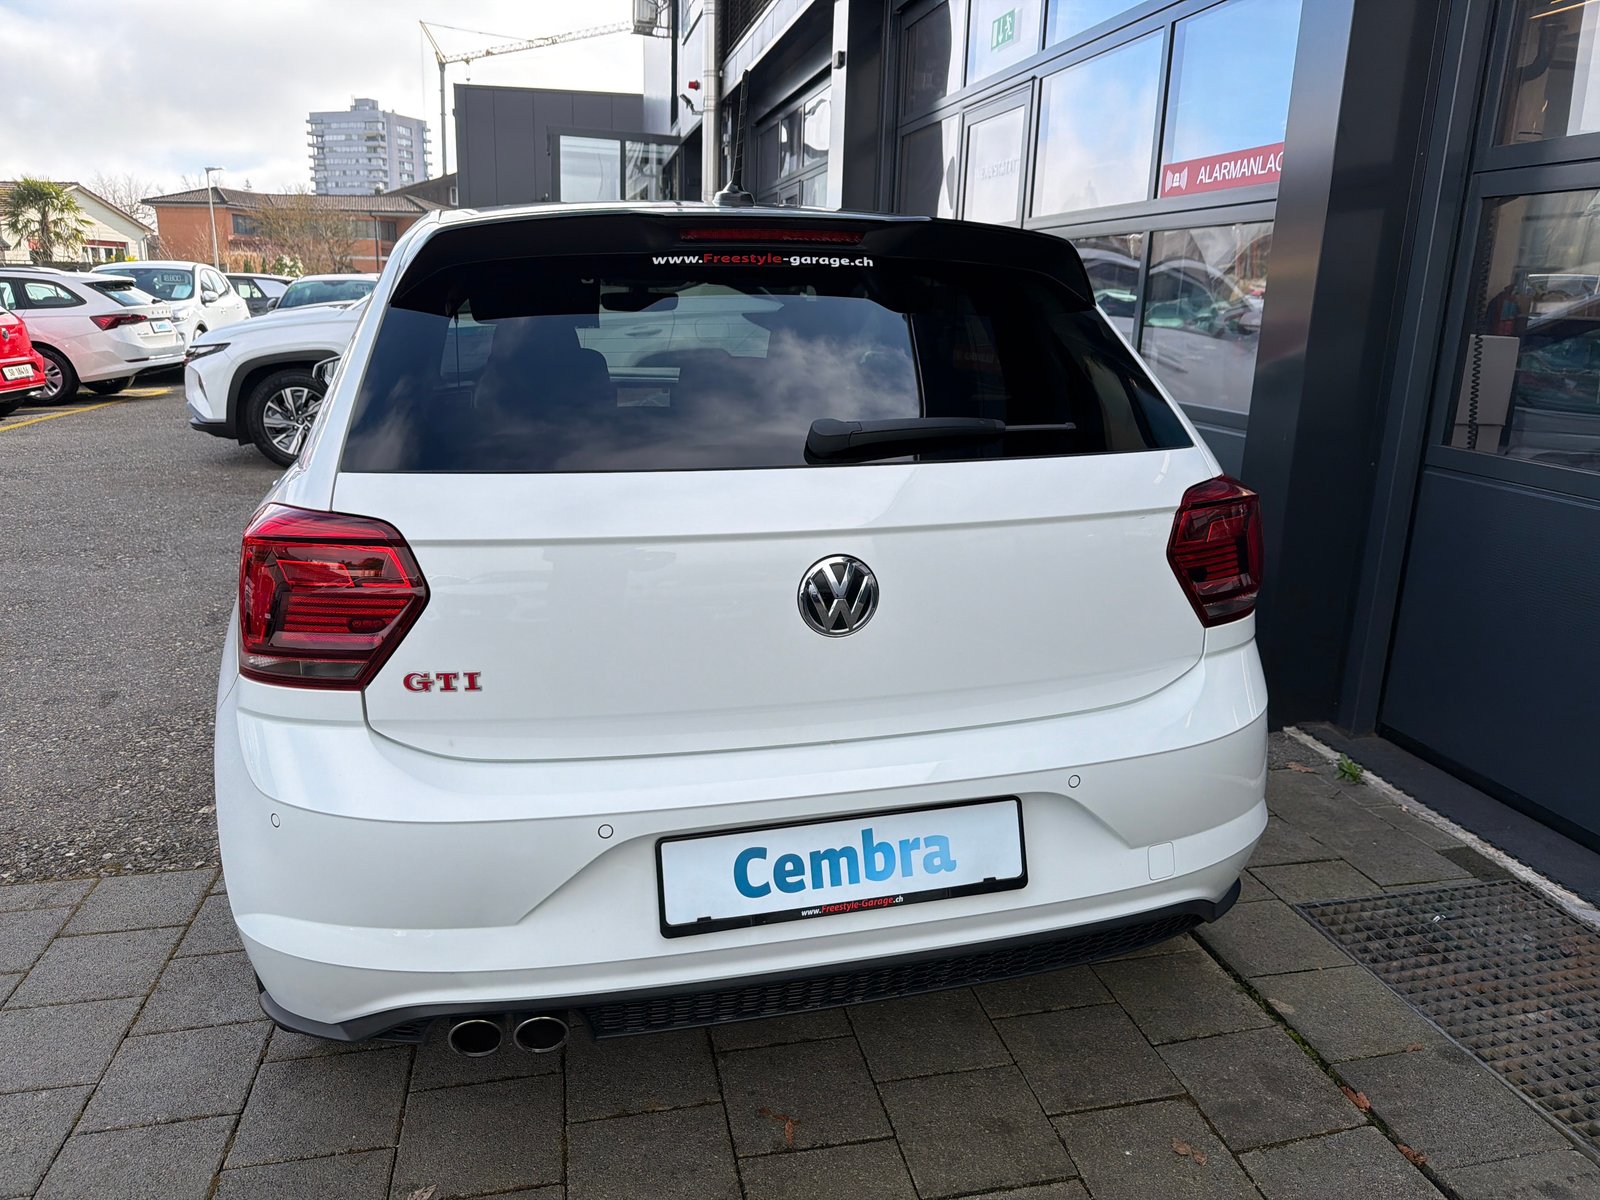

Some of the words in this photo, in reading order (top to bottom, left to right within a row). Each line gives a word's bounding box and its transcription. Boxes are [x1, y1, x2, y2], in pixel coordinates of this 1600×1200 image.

[652, 253, 875, 268] www.Freestyle-garage.ch
[403, 671, 482, 692] GTI
[733, 827, 957, 899] Cembra
[801, 894, 904, 917] www.Freestyle-Garage.ch
